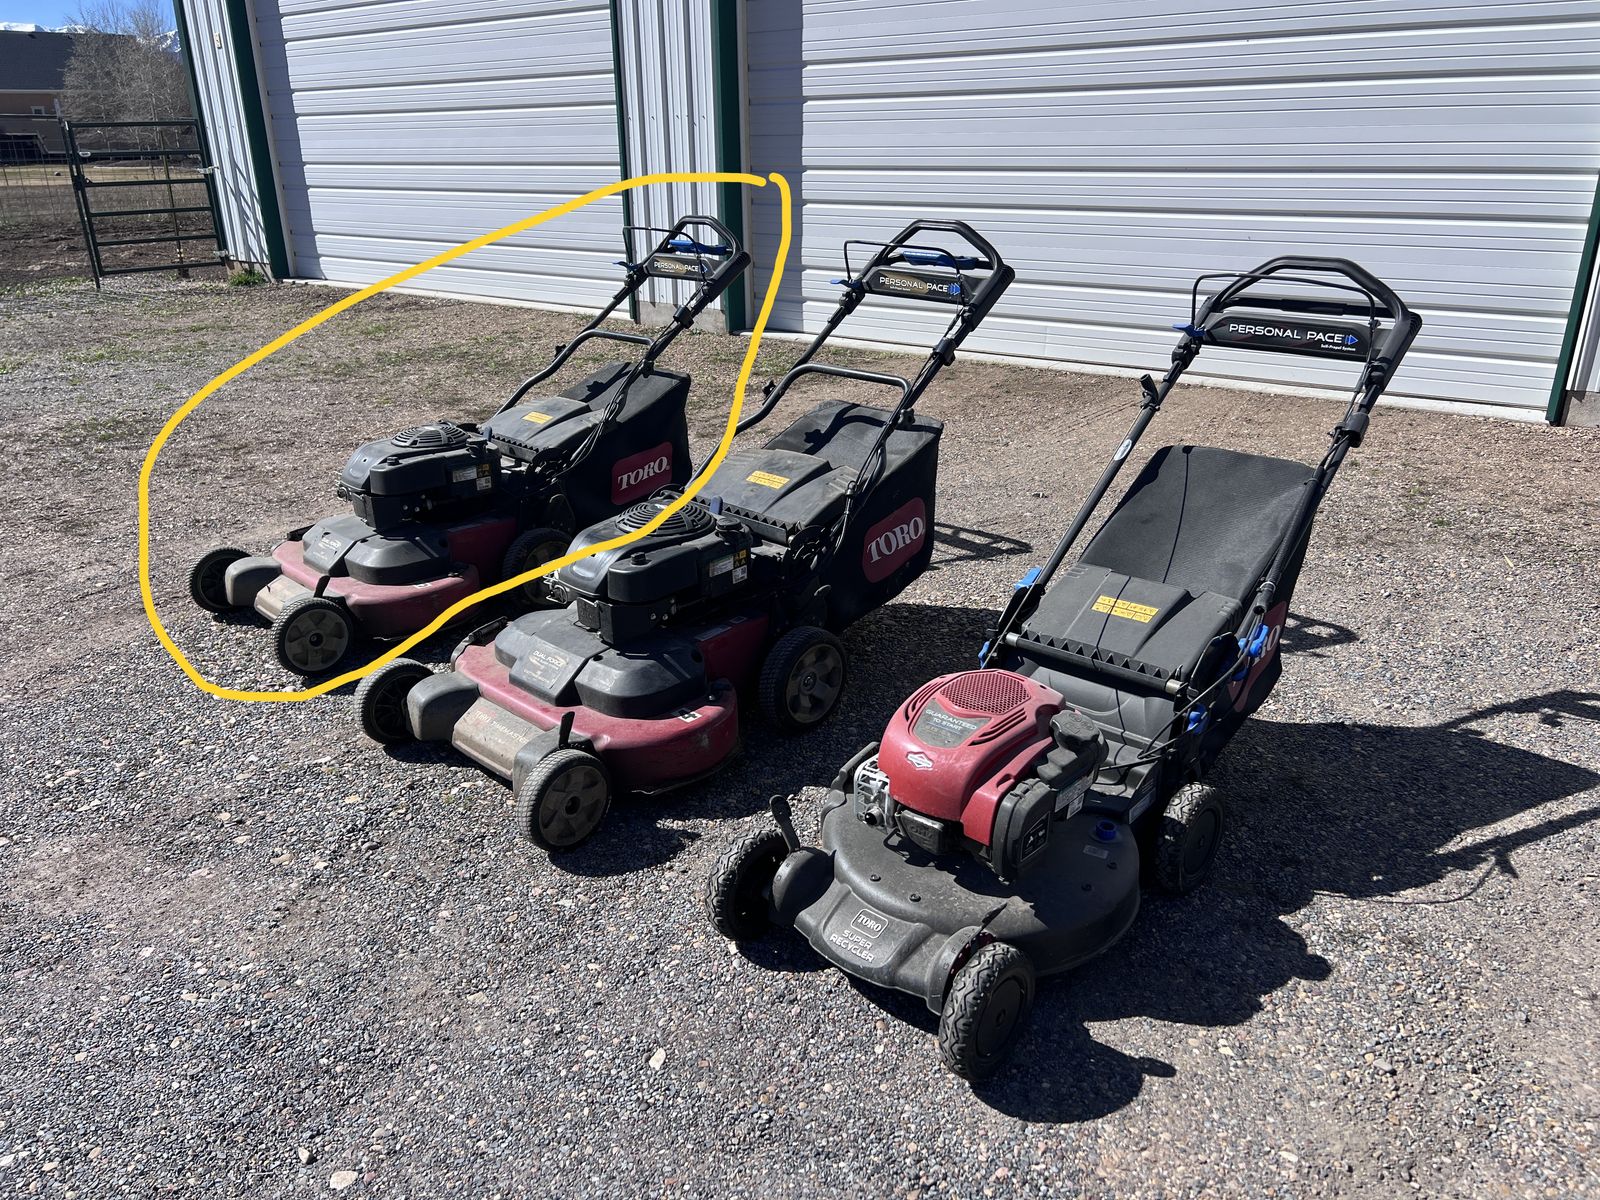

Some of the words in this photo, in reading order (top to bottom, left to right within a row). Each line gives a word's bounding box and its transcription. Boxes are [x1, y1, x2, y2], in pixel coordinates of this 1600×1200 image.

[654, 261, 684, 272] PERSONAL
[684, 264, 699, 273] PACE
[879, 276, 923, 289] PERSONAL
[926, 282, 949, 293] PACE
[1228, 323, 1302, 340] PERSONAL
[1306, 330, 1344, 344] PACE
[617, 456, 668, 491] TORO
[866, 516, 924, 563] TORO
[925, 708, 977, 730] GUARANTEED
[942, 720, 964, 731] START
[857, 913, 882, 932] TORO
[829, 933, 875, 963] RECYCLER
[842, 929, 873, 950] SUPER
